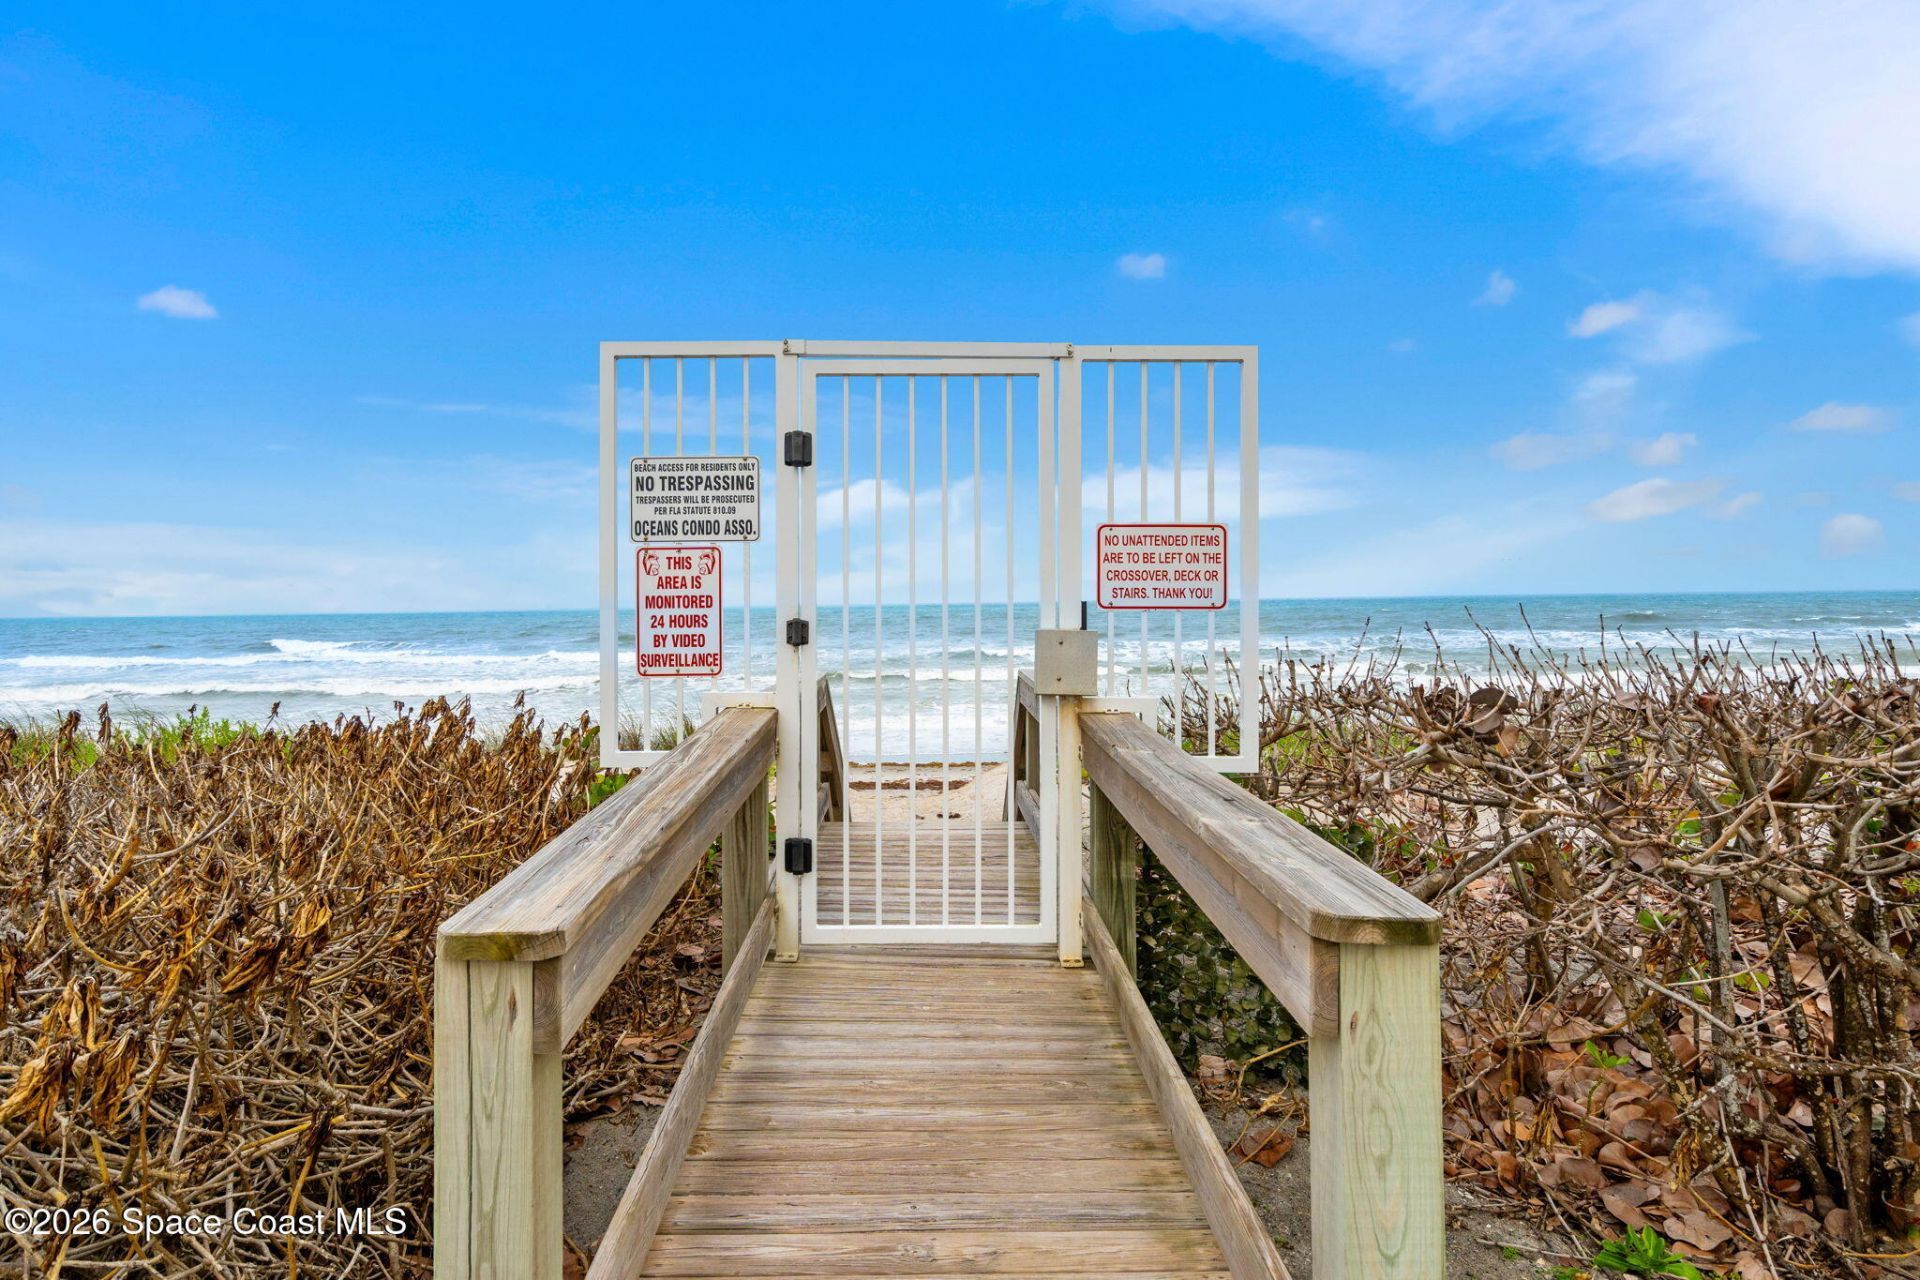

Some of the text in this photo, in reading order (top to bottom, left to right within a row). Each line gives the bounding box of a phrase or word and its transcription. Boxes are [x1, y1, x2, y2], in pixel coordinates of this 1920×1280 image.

[739, 463, 755, 471] ONLY
[636, 475, 754, 491] NO TRESPASSING
[636, 496, 681, 504] TRESPASSERS
[635, 520, 756, 536] OCEANS CONDO ASSO.
[1105, 535, 1220, 546] NO UNATTENDED ITEMS
[666, 557, 692, 570] THIS
[1103, 553, 1221, 563] ARE TO BE LEFT ON THE
[657, 576, 702, 589] AREA IS
[1107, 570, 1218, 583] CROSSOVER, DECK OR
[1112, 588, 1212, 599] STAIRS. THANK YOU!
[646, 595, 713, 609] MONITORED
[650, 615, 708, 628] 24 HOURS
[654, 634, 705, 647] BY VIDEO
[641, 653, 718, 667] SURVEILLANCE
